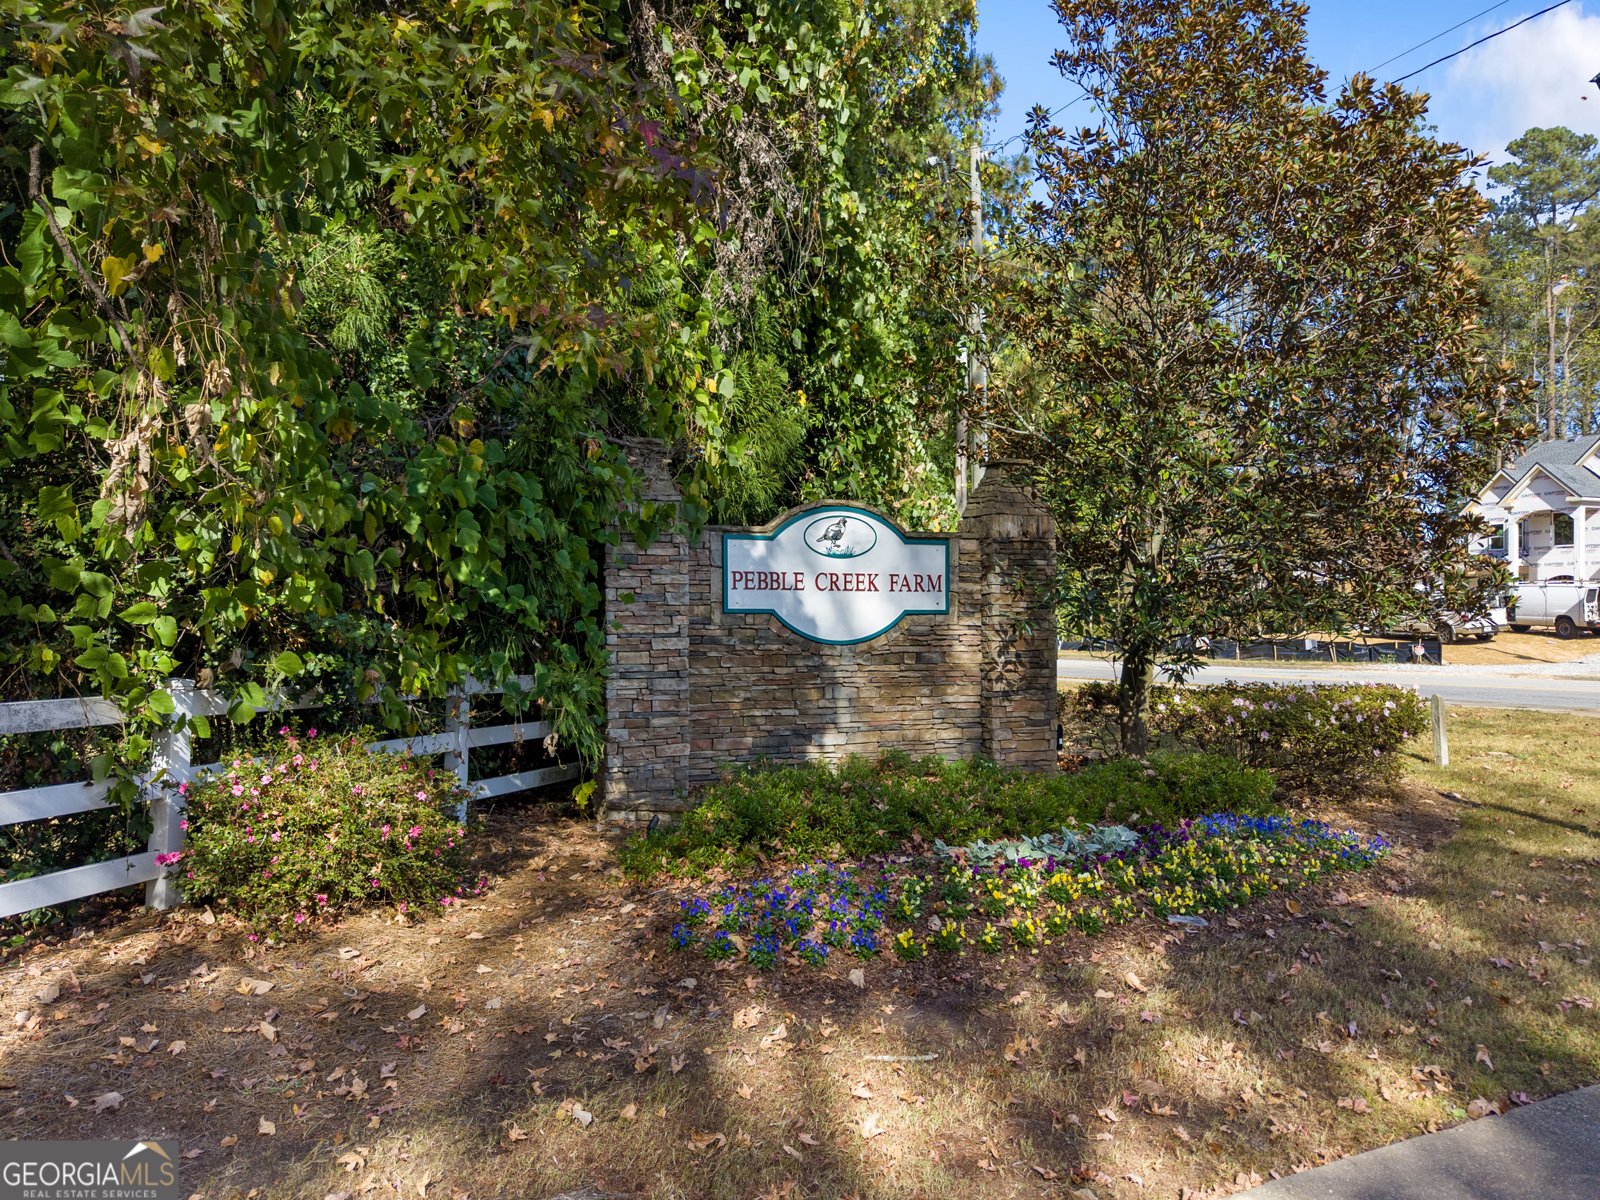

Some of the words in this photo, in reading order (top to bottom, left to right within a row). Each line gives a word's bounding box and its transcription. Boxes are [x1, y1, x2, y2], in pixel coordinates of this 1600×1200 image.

[731, 571, 805, 591] PEBBLE
[815, 572, 880, 592] CREEK
[889, 573, 943, 593] FARM
